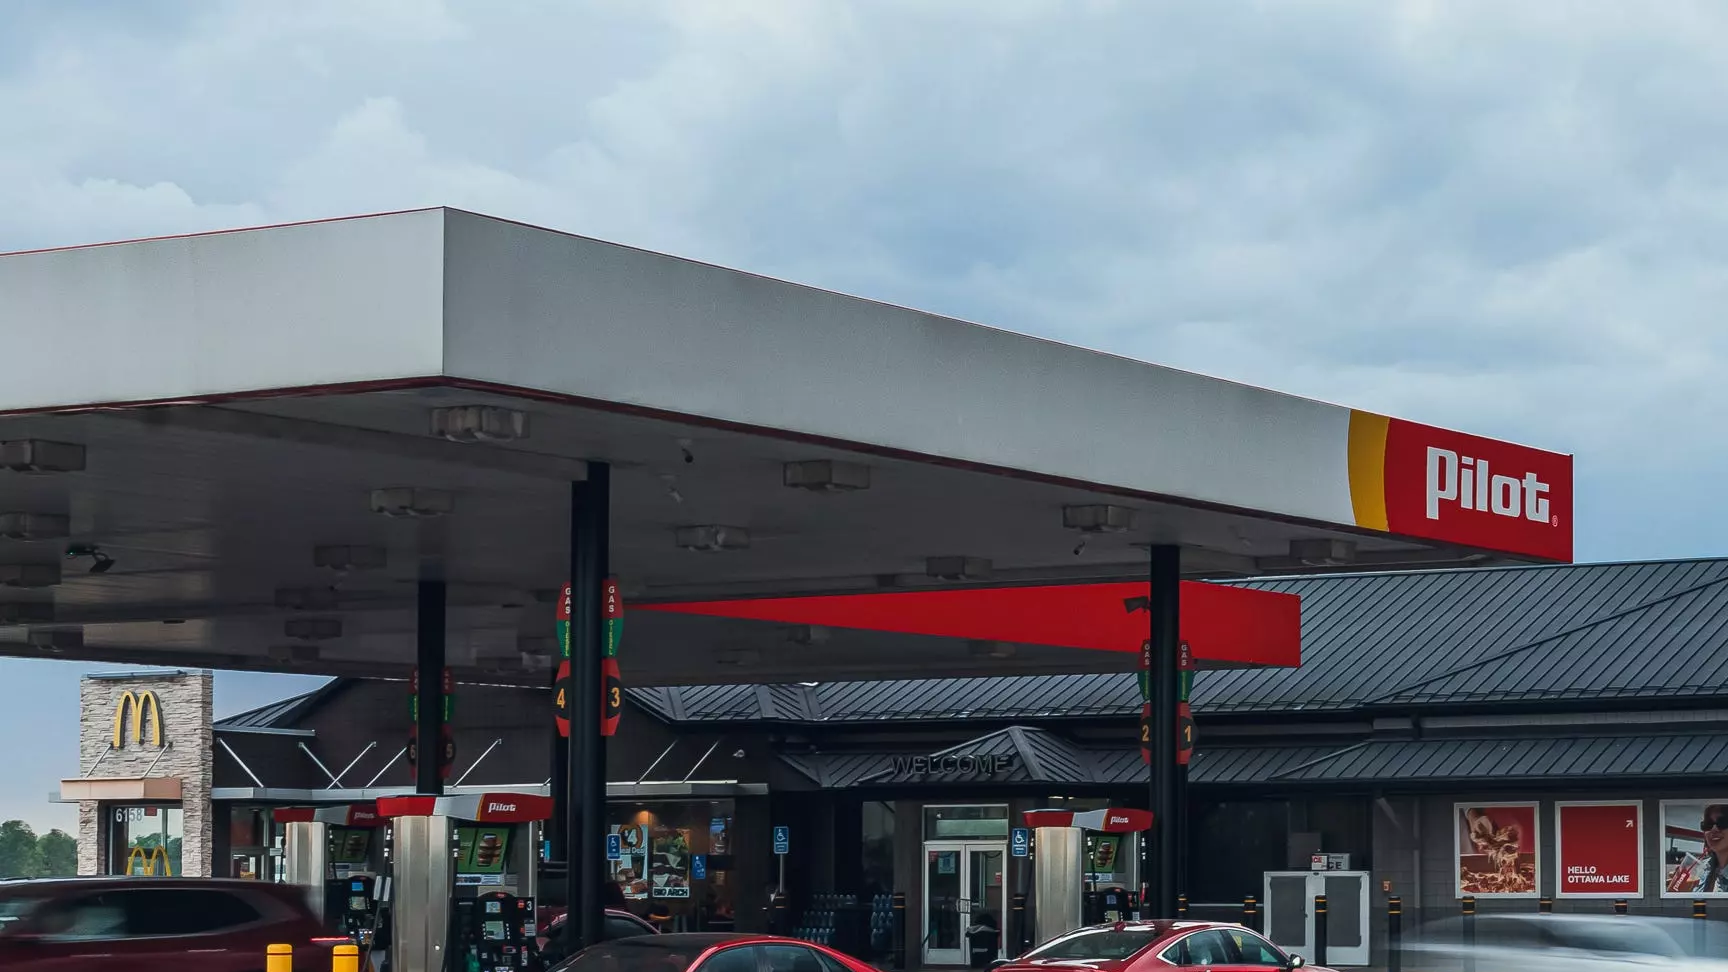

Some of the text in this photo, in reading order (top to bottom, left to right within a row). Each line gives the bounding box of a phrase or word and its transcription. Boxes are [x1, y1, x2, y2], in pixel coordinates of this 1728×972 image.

[1426, 446, 1550, 524] Pilot
[556, 688, 566, 709] 4
[611, 687, 620, 708] 3
[1142, 725, 1150, 742] 2
[1184, 725, 1192, 742] 1
[891, 756, 1009, 775] WELCOME
[115, 808, 143, 823] 6158
[488, 802, 517, 813] Pilot
[1567, 866, 1597, 874] HELLO
[1567, 875, 1630, 883] OTTAWA LAKE
[667, 888, 688, 897] ARCH
